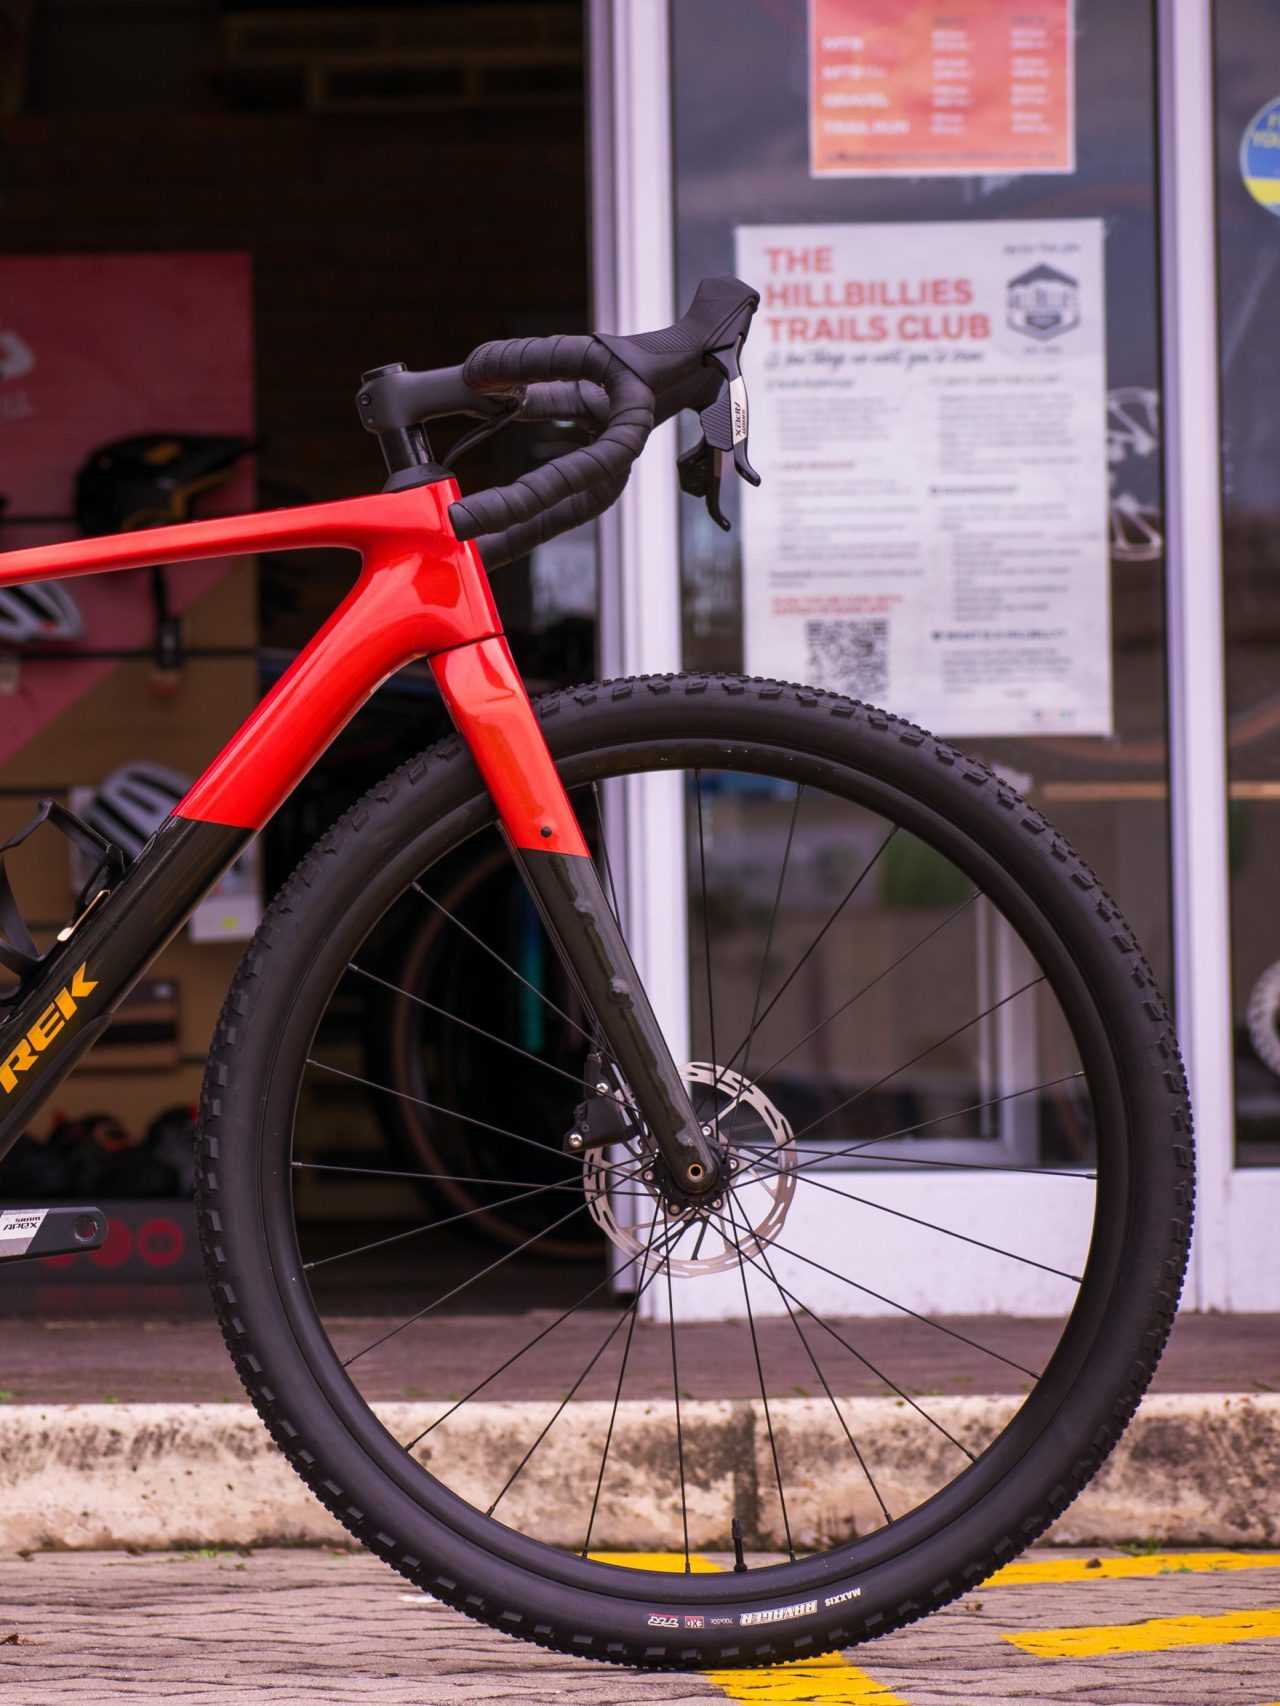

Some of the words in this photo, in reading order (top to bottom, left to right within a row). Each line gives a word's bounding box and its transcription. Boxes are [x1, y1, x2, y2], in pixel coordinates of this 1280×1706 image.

[765, 246, 833, 275] THE
[765, 279, 974, 310] HILLBILLIES
[766, 315, 890, 345] TRAILS
[897, 313, 992, 342] CLUB
[825, 1588, 861, 1607] MAXXIS
